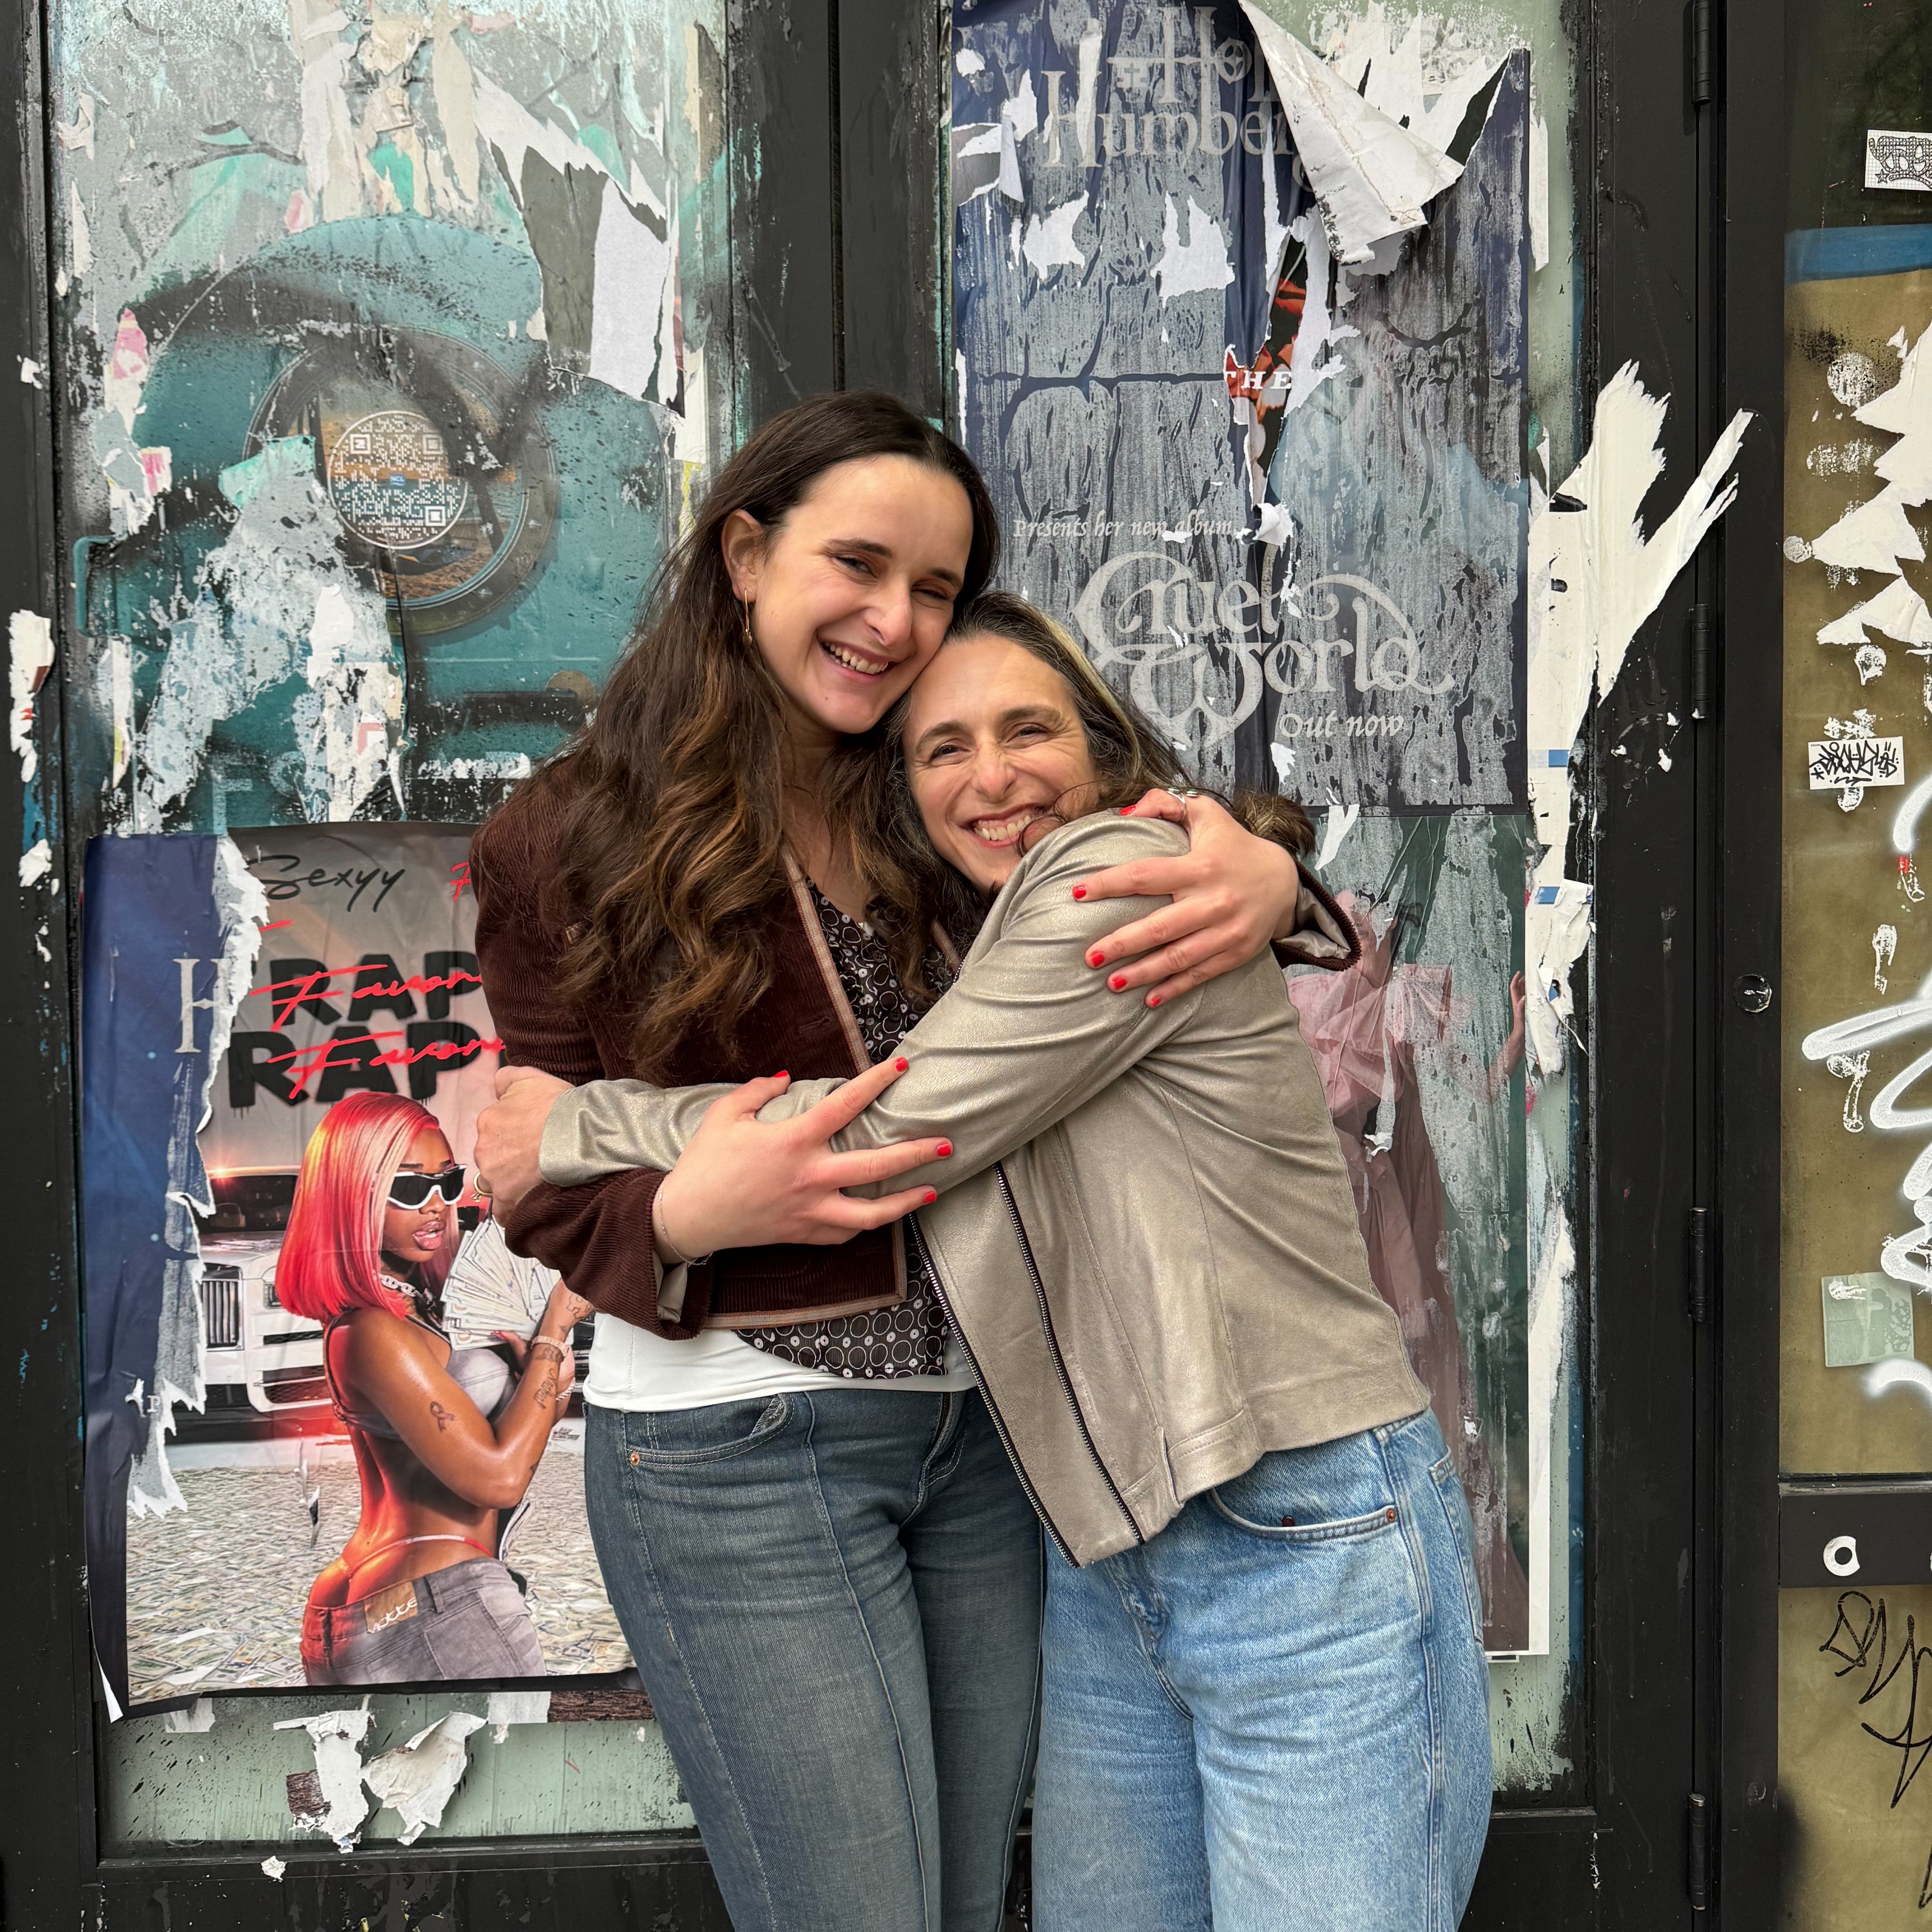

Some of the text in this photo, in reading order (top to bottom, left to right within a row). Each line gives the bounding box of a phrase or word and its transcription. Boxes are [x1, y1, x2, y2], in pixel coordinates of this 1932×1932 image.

[1013, 518, 1089, 538] Presents
[1094, 510, 1124, 537] her
[1130, 520, 1167, 537] new
[1129, 574, 1456, 747] World
[1279, 710, 1404, 738] Out now
[246, 855, 405, 912] Sexyy
